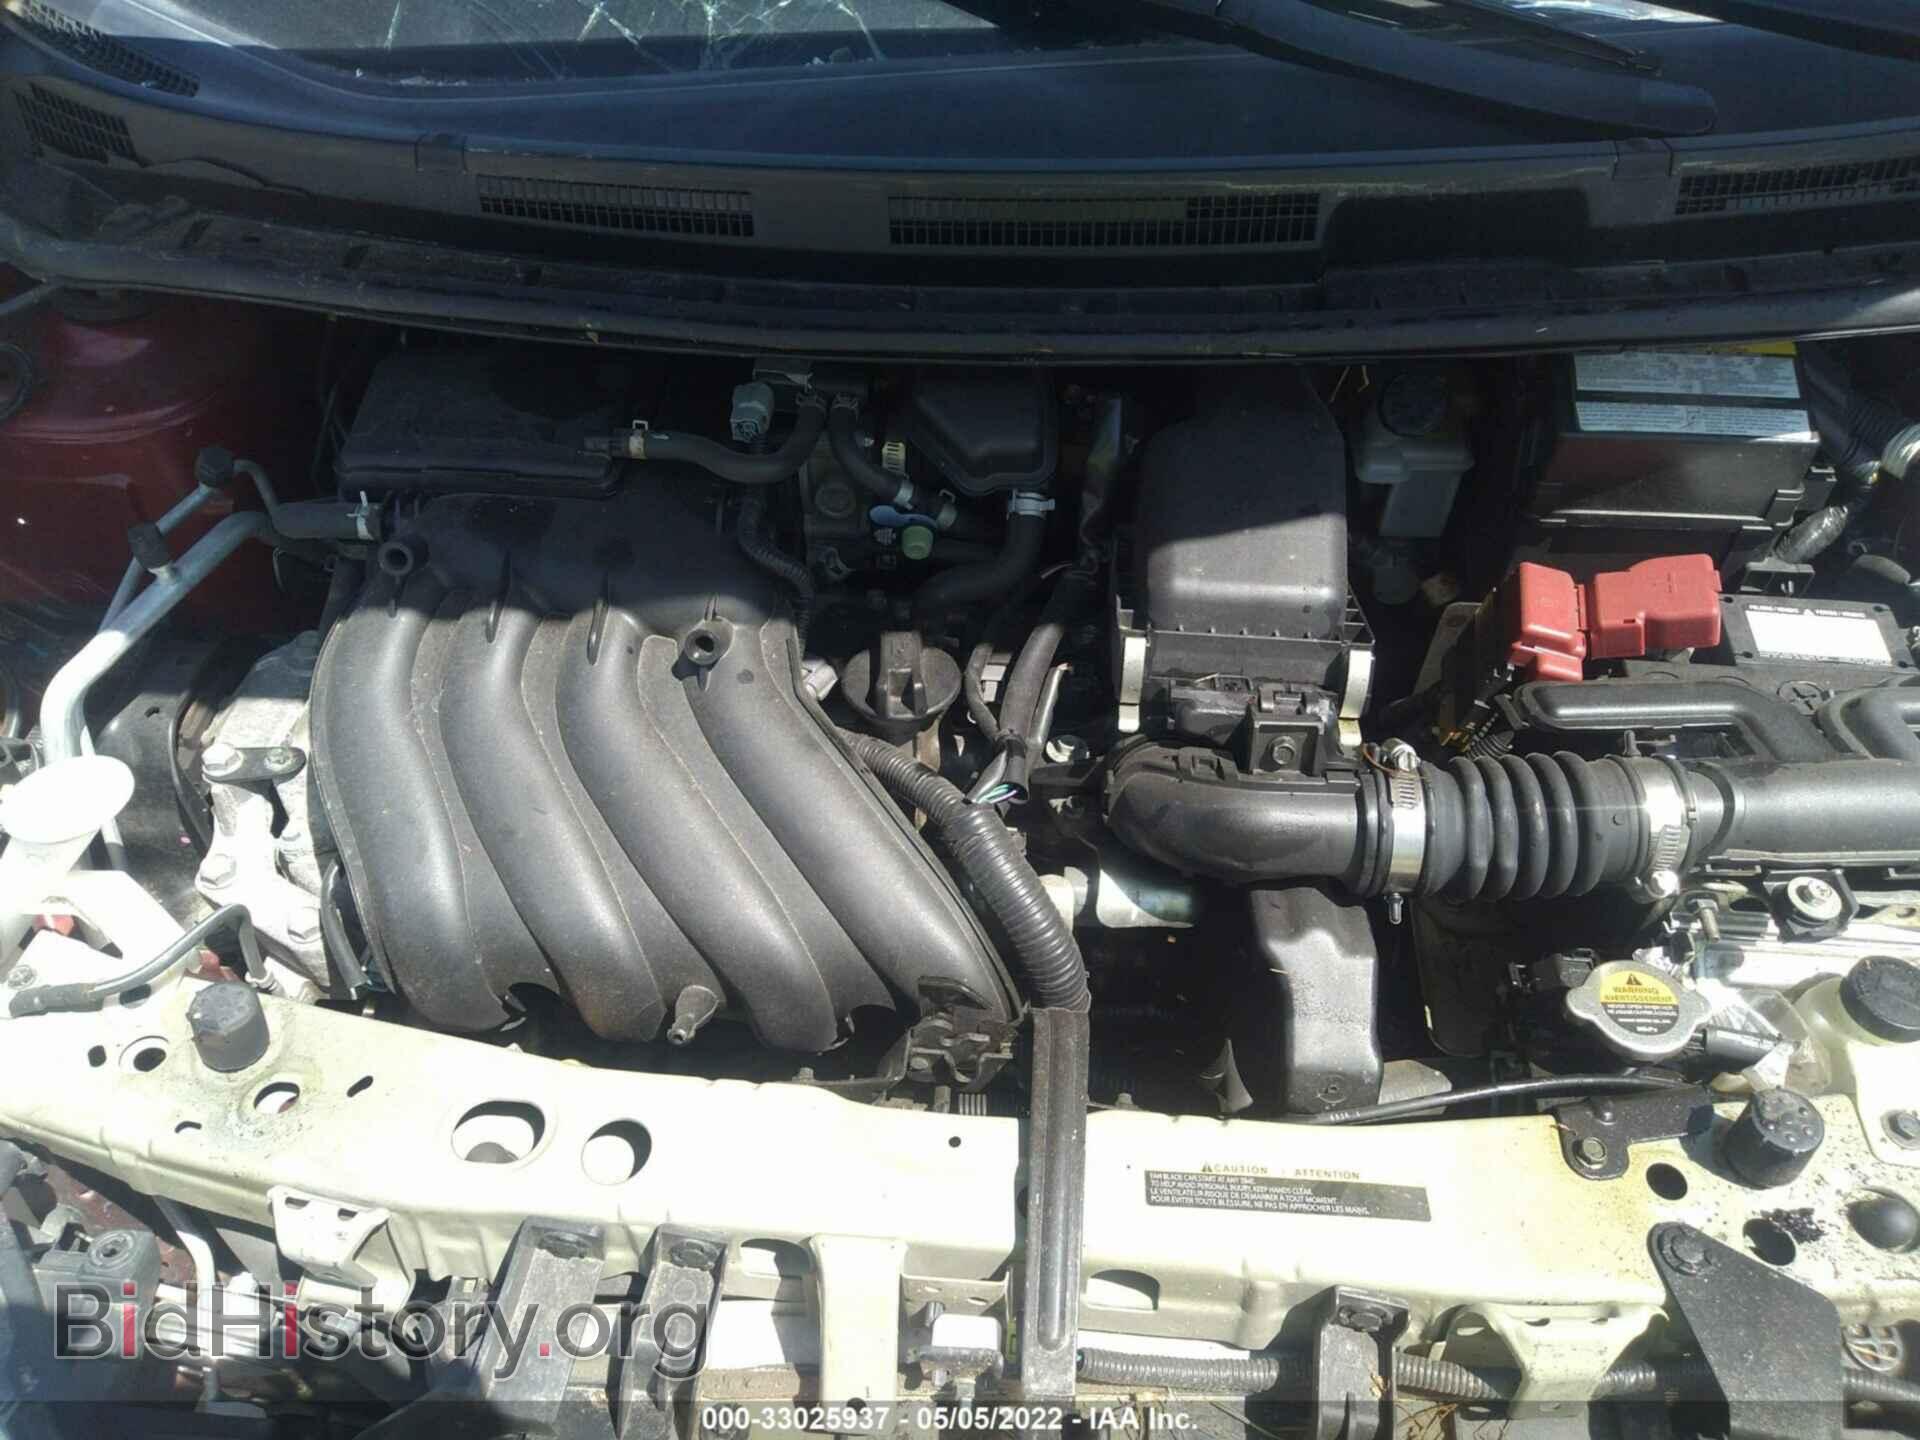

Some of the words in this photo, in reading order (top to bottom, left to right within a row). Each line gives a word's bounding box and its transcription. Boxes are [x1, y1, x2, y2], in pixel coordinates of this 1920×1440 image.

[1613, 986, 1659, 994] WARNING
[1214, 1164, 1268, 1174] CAUTION
[1295, 1168, 1361, 1180] ATTENTION
